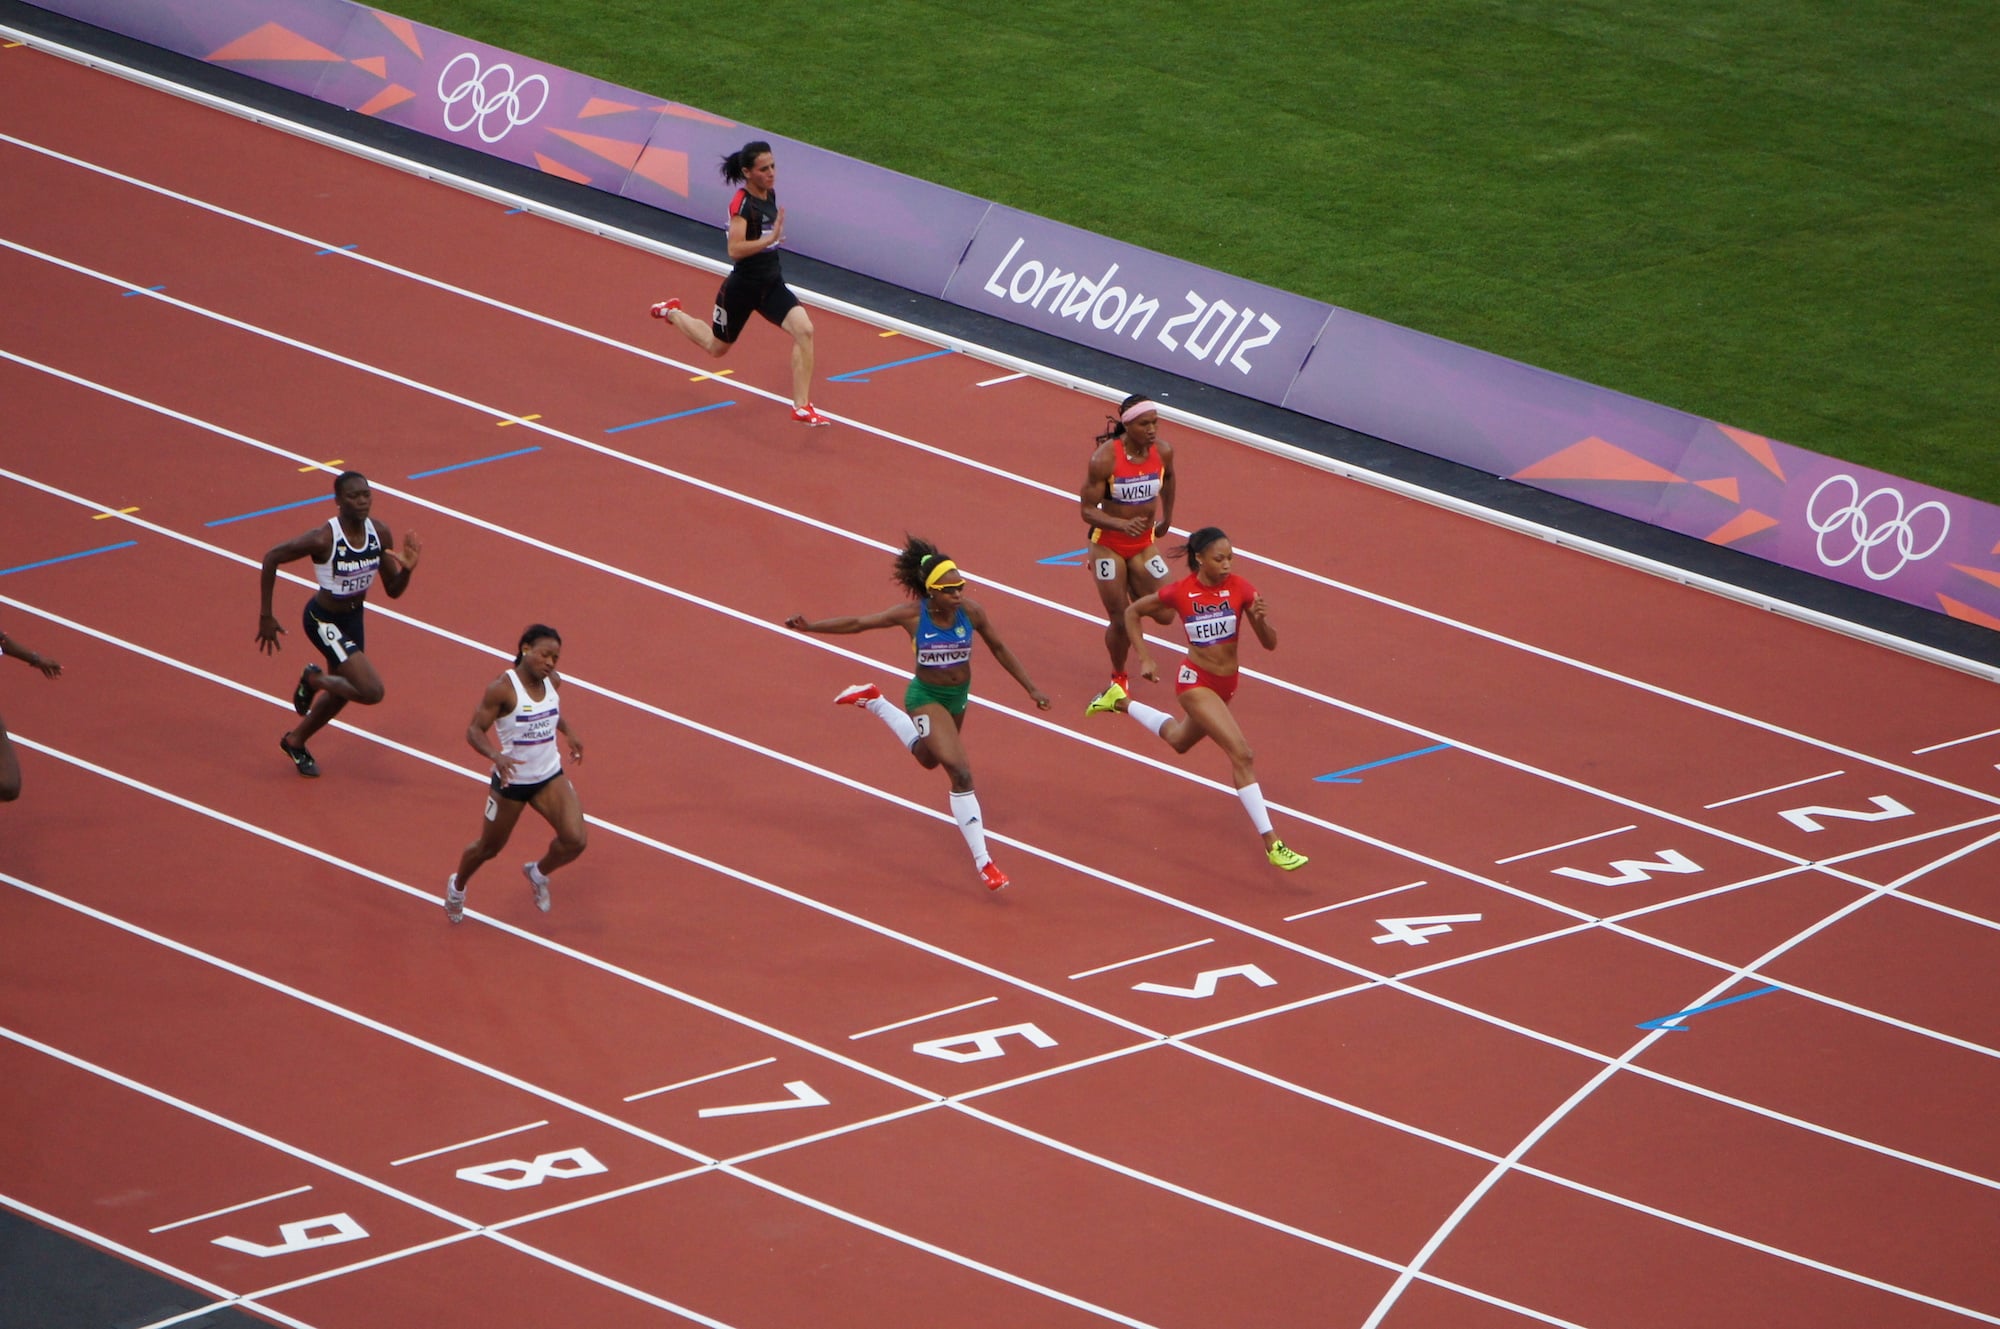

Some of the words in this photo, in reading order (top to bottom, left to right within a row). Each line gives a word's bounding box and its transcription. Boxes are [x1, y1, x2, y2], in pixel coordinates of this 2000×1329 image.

[715, 308, 722, 322] 2
[984, 237, 1160, 341] London
[1157, 290, 1281, 375] 2012
[337, 560, 359, 572] Virgin
[326, 626, 335, 640] 6
[1196, 621, 1228, 639] FELIX
[920, 651, 968, 663] SANTOS
[1182, 670, 1191, 681] 4
[528, 719, 550, 731] ZANG
[918, 718, 924, 735] 5
[487, 799, 494, 814] 7
[1777, 794, 1916, 833] 2
[1550, 848, 1705, 887] 3
[1371, 913, 1482, 946] 4
[1130, 963, 1278, 999] 5
[912, 1022, 1060, 1064] 6
[698, 1080, 831, 1118] 7
[455, 1147, 609, 1191] 8
[210, 1212, 371, 1259] 9
